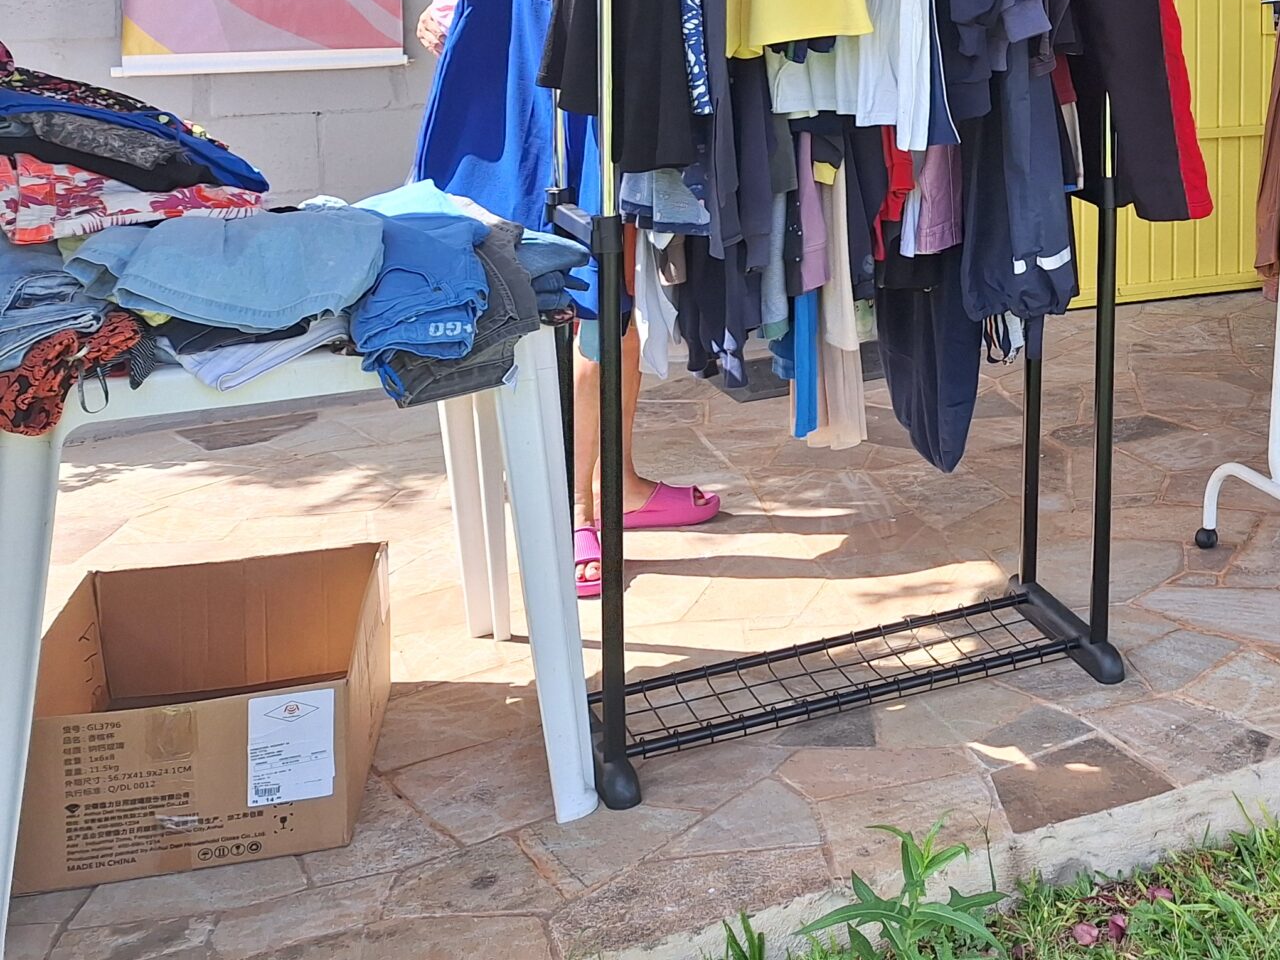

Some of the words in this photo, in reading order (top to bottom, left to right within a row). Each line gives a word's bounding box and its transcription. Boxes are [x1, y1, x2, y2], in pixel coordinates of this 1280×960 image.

[87, 721, 122, 731] GL3796
[67, 863, 94, 872] MADE
[95, 859, 106, 868] IN
[107, 857, 137, 867] CHINA
